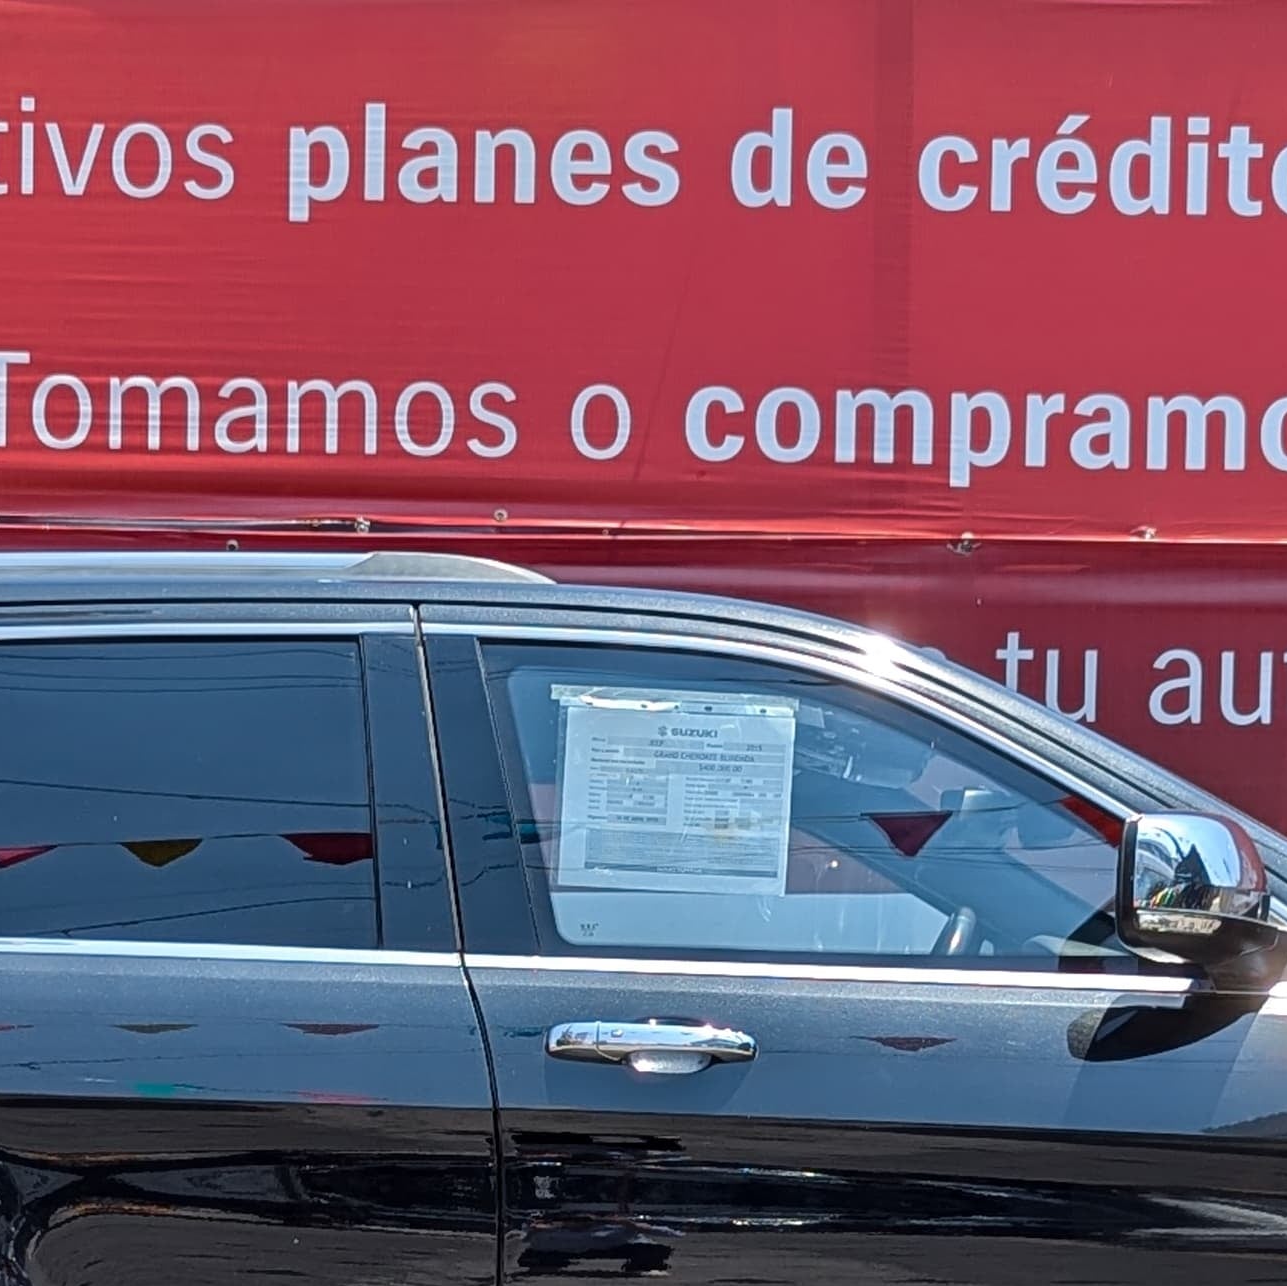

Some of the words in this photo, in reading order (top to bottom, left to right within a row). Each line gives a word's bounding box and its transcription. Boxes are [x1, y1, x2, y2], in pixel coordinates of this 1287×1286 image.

[289, 103, 681, 223] planes
[731, 108, 868, 209] de
[571, 384, 631, 460] o
[996, 630, 1099, 725] tu
[671, 728, 718, 739] SUZUKI
